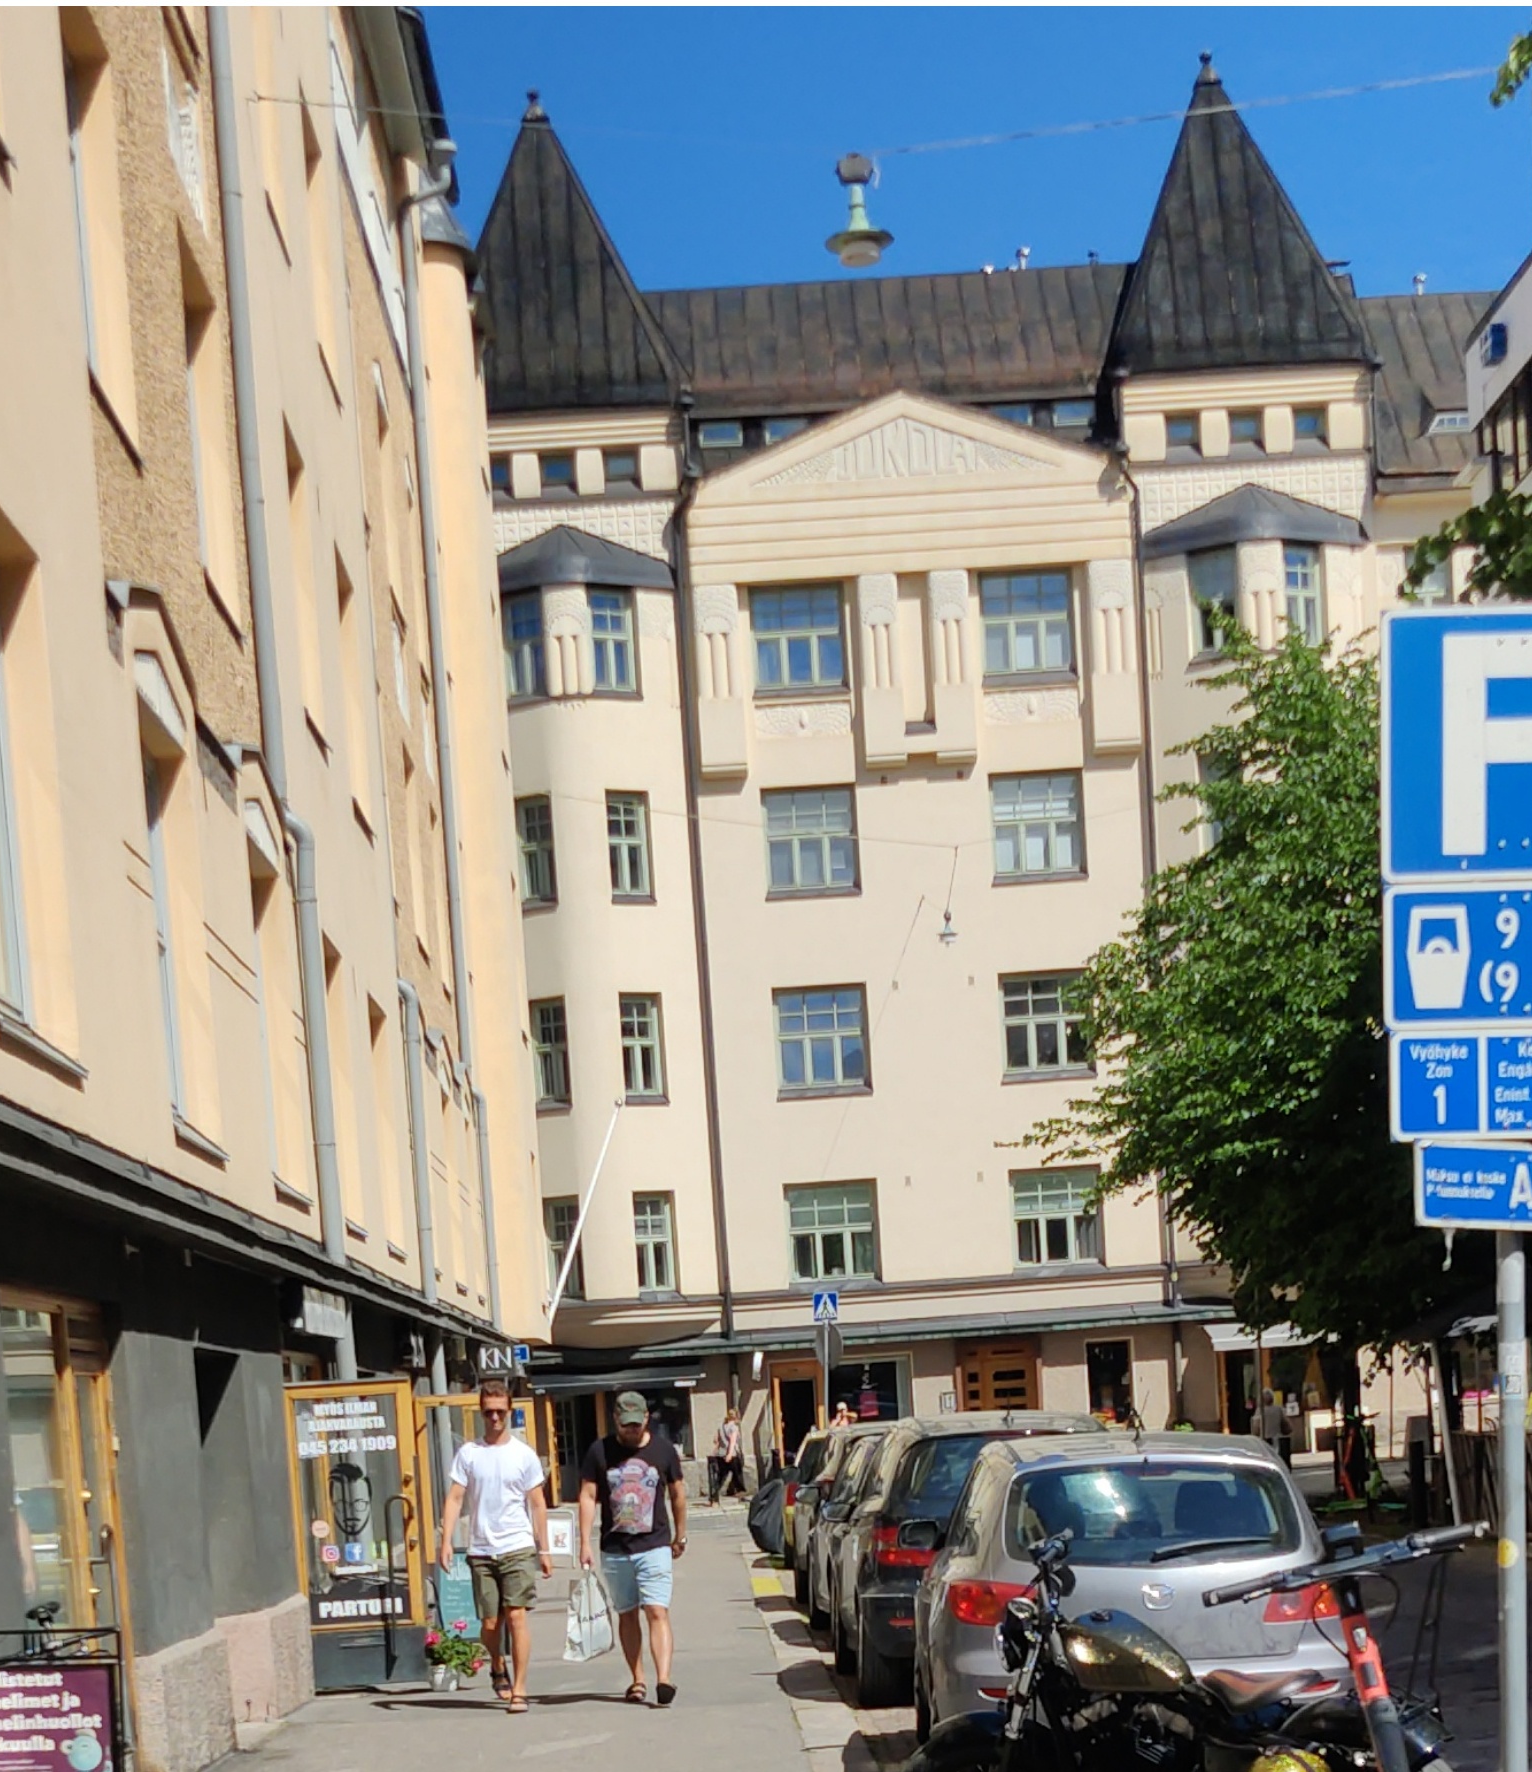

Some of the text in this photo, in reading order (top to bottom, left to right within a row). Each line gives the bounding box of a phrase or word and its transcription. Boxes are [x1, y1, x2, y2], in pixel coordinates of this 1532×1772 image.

[1495, 907, 1519, 949] 9
[1479, 960, 1519, 1003] (9
[1425, 1062, 1454, 1079] Zon
[1432, 1083, 1447, 1125] 1
[479, 1345, 513, 1370] KN
[359, 1434, 397, 1451] 1909
[61, 1690, 82, 1712] ja
